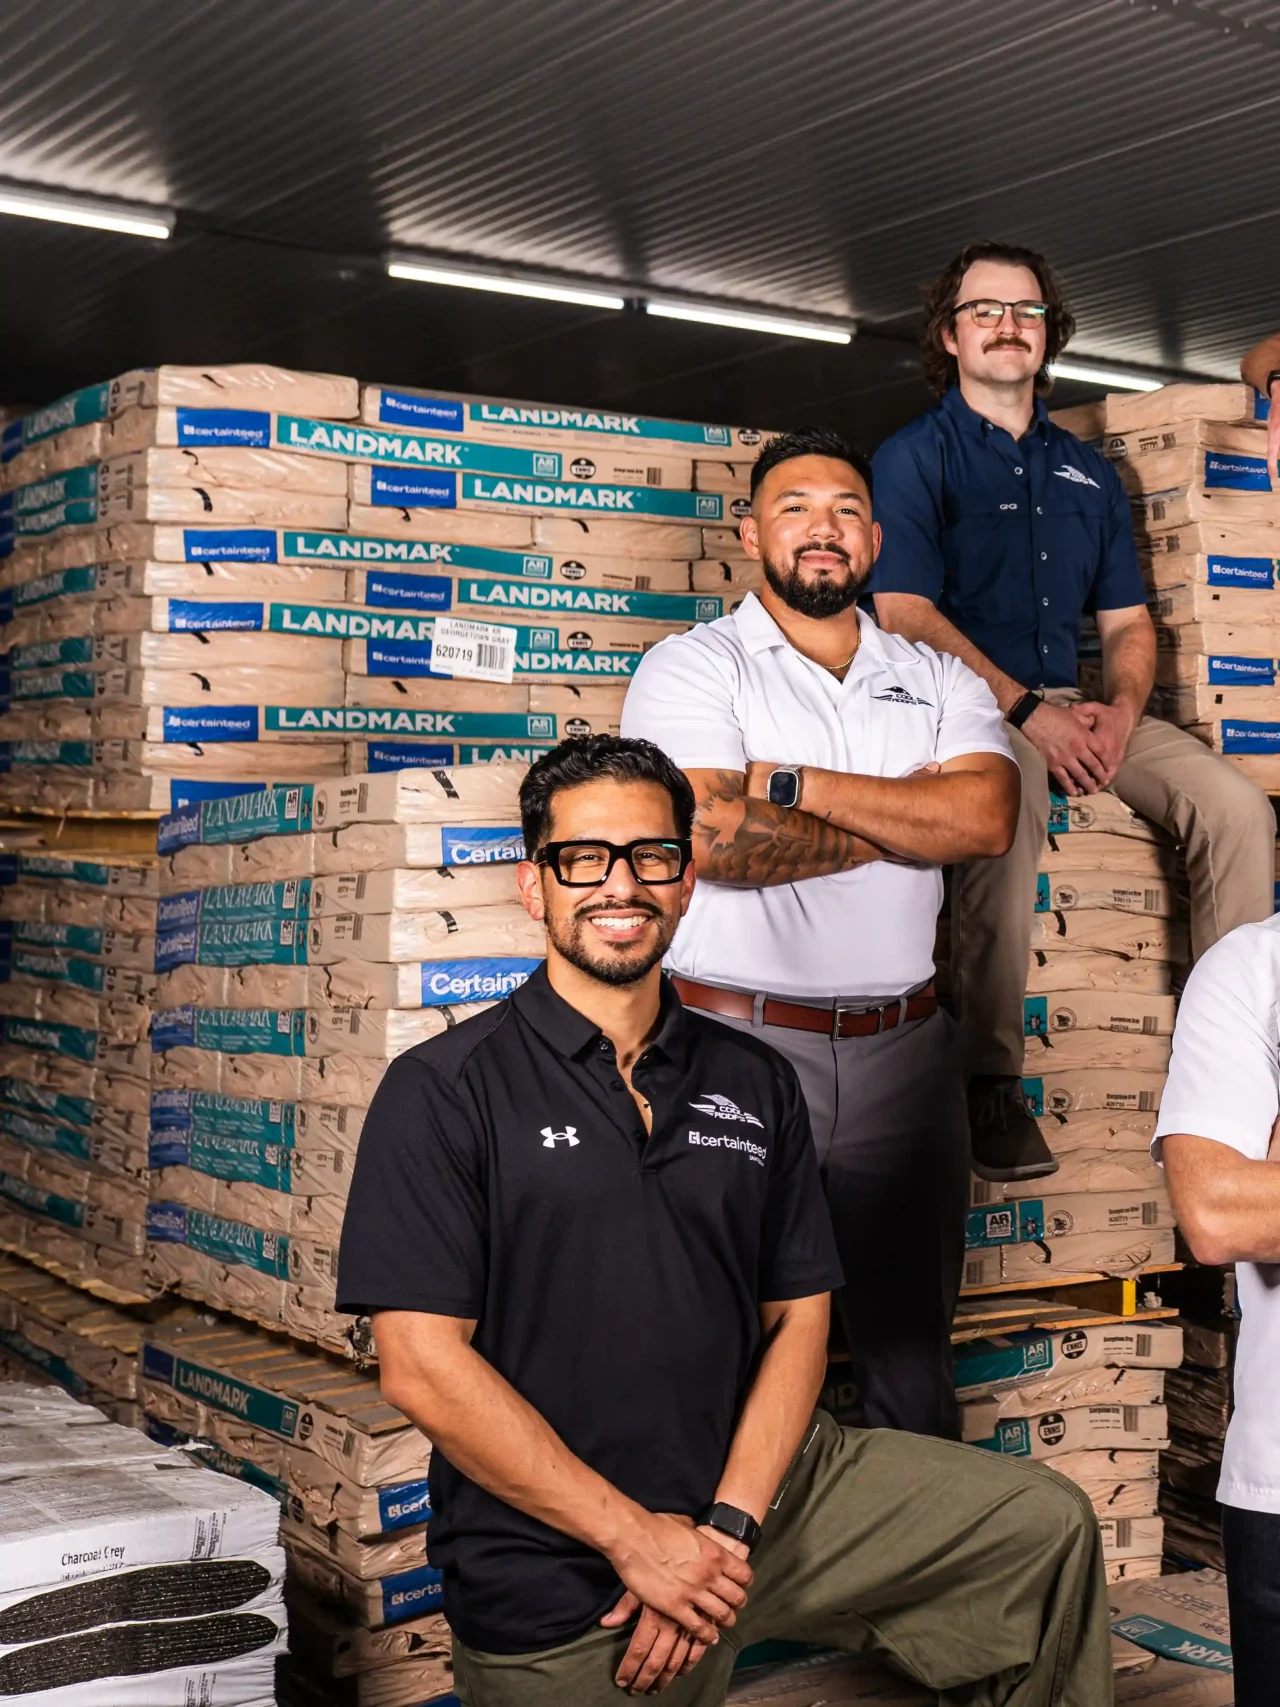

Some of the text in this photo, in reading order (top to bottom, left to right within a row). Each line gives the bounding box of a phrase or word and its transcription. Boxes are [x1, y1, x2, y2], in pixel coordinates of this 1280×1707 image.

[481, 404, 641, 434] LANDMARK
[195, 421, 463, 465] certainteed LANDMARK
[387, 479, 634, 509] certainteed LANDMARK
[203, 536, 453, 562] certainteed LANDMARK
[1221, 565, 1268, 579] certainteed
[382, 583, 630, 613] certainteed LANDMARK
[282, 608, 435, 640] LANDMAR
[436, 644, 473, 662] 620719
[1221, 661, 1268, 674] certainteed
[181, 709, 455, 732] certainteed LANDMARK
[203, 789, 279, 828] LANDMARK
[701, 1135, 767, 1159] certainteed
[989, 1214, 1009, 1225] AR
[1028, 1343, 1044, 1354] AR
[1066, 1342, 1083, 1351] ENNIS
[179, 1368, 249, 1415] LANDMARK
[1005, 1428, 1021, 1438] AR
[1043, 1425, 1061, 1434] ENNIS
[61, 1545, 125, 1566] Charcoal Grey
